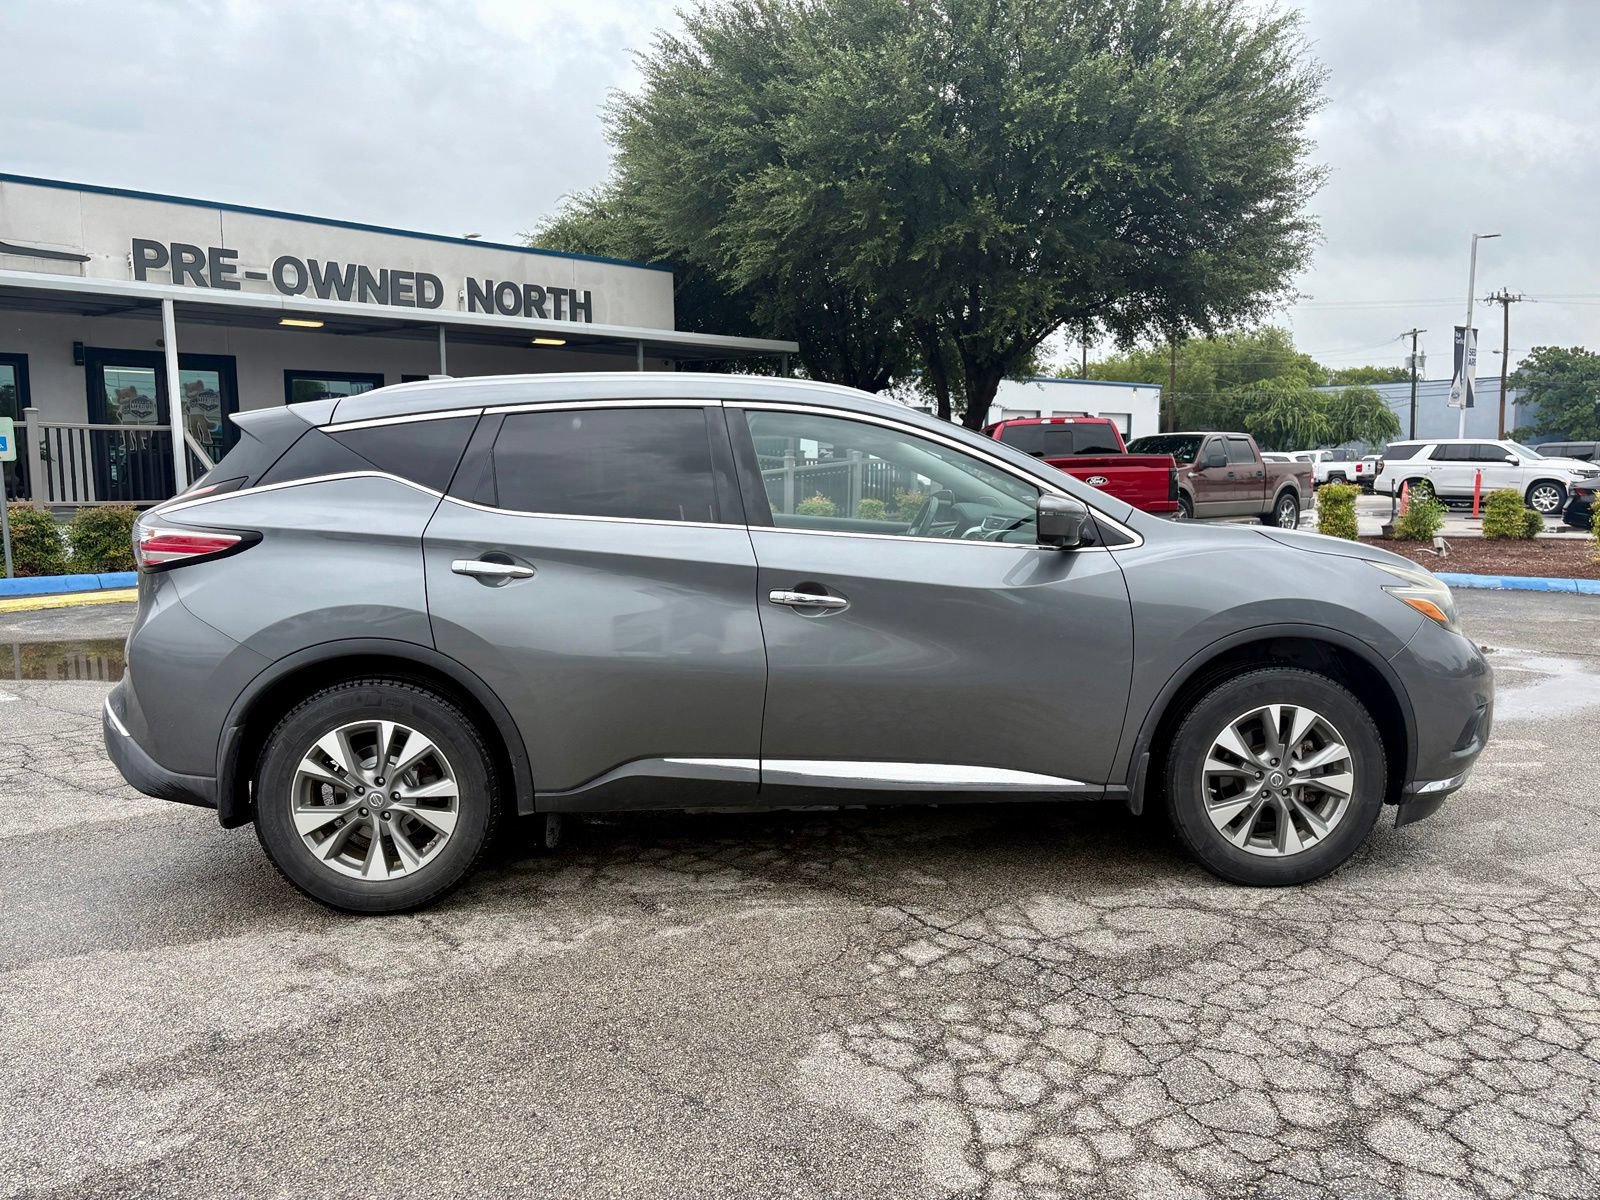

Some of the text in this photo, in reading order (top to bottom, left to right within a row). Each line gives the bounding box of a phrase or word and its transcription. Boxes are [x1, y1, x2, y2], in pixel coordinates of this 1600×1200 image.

[132, 238, 592, 323] PRE-OWNED NORTH
[1088, 476, 1106, 486] Ford
